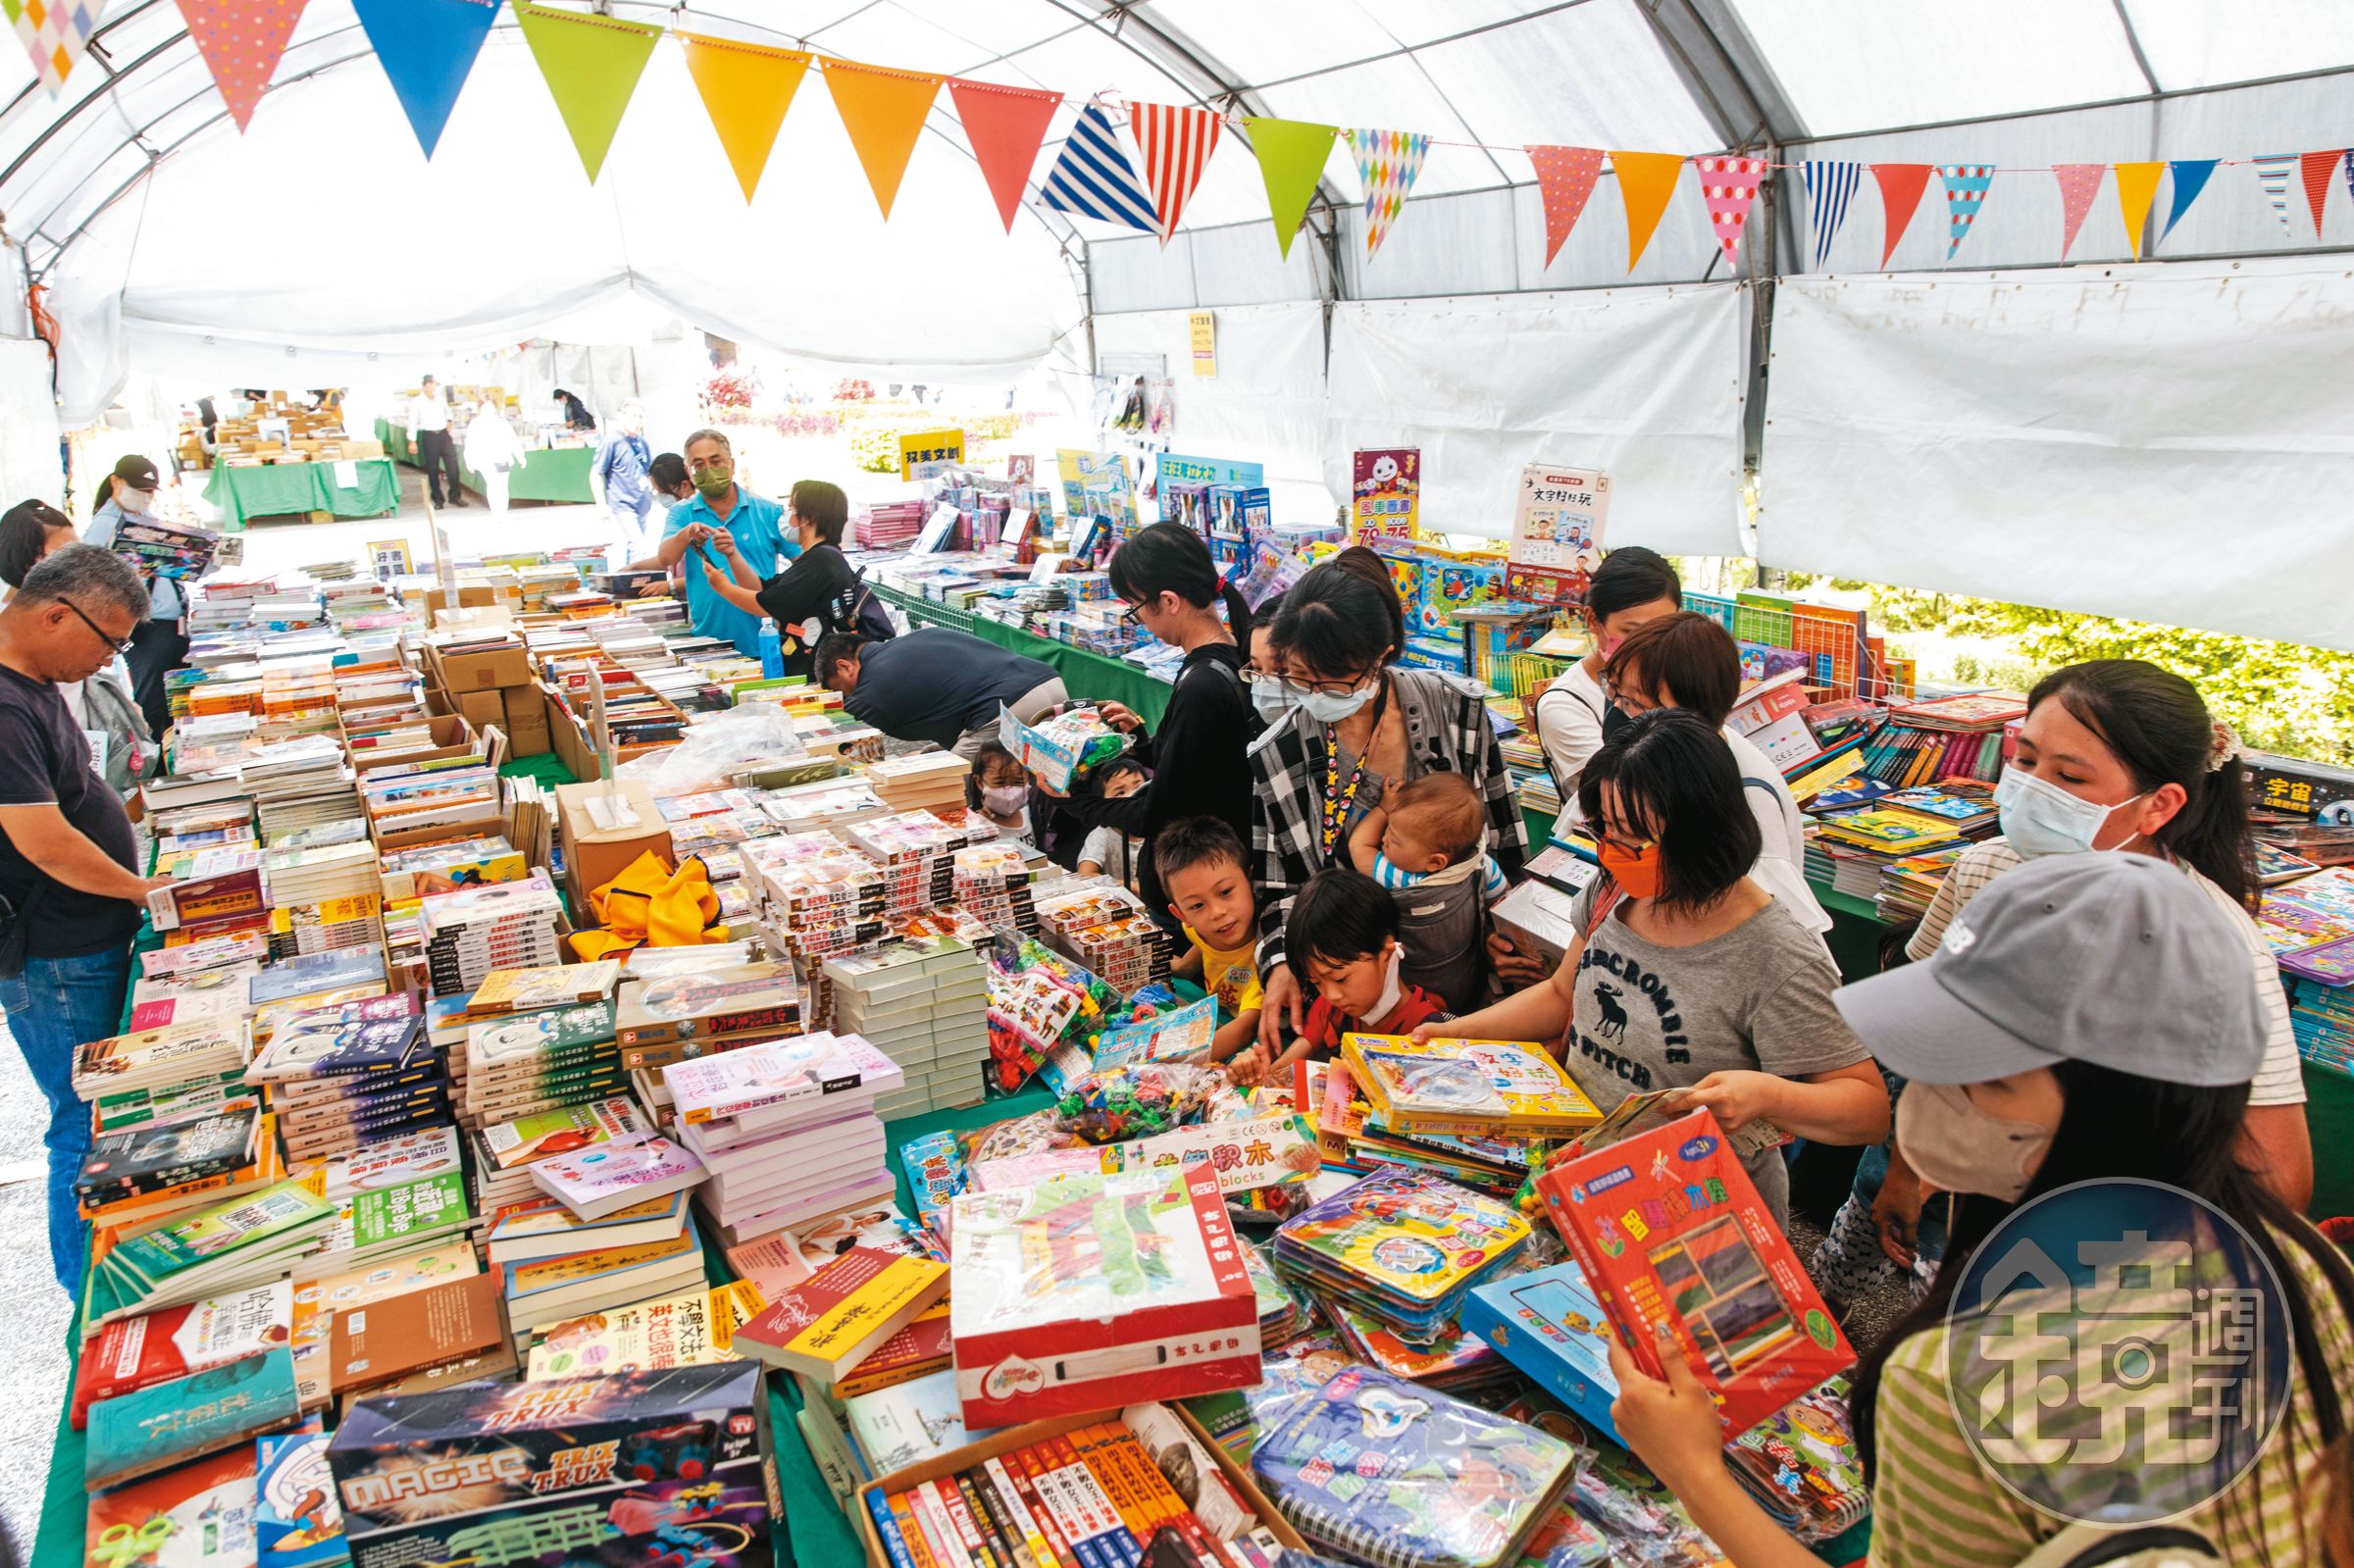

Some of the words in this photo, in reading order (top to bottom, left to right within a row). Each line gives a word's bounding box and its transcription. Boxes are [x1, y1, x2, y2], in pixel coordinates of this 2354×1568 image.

[904, 446, 960, 464] 双美文創
[1359, 498, 1411, 516] 風車圖書
[1533, 488, 1593, 507] 文字好好玩
[2267, 778, 2312, 802] 宇宙
[1221, 1171, 1265, 1188] blocks
[647, 1303, 675, 1371] 英文也很棒
[677, 1298, 705, 1357] 不學文法
[518, 1379, 606, 1408] TRIX
[480, 1398, 594, 1434] TRUX
[548, 1439, 622, 1473] TRIX
[339, 1446, 532, 1513] MAGIC
[531, 1461, 615, 1495] TRUX
